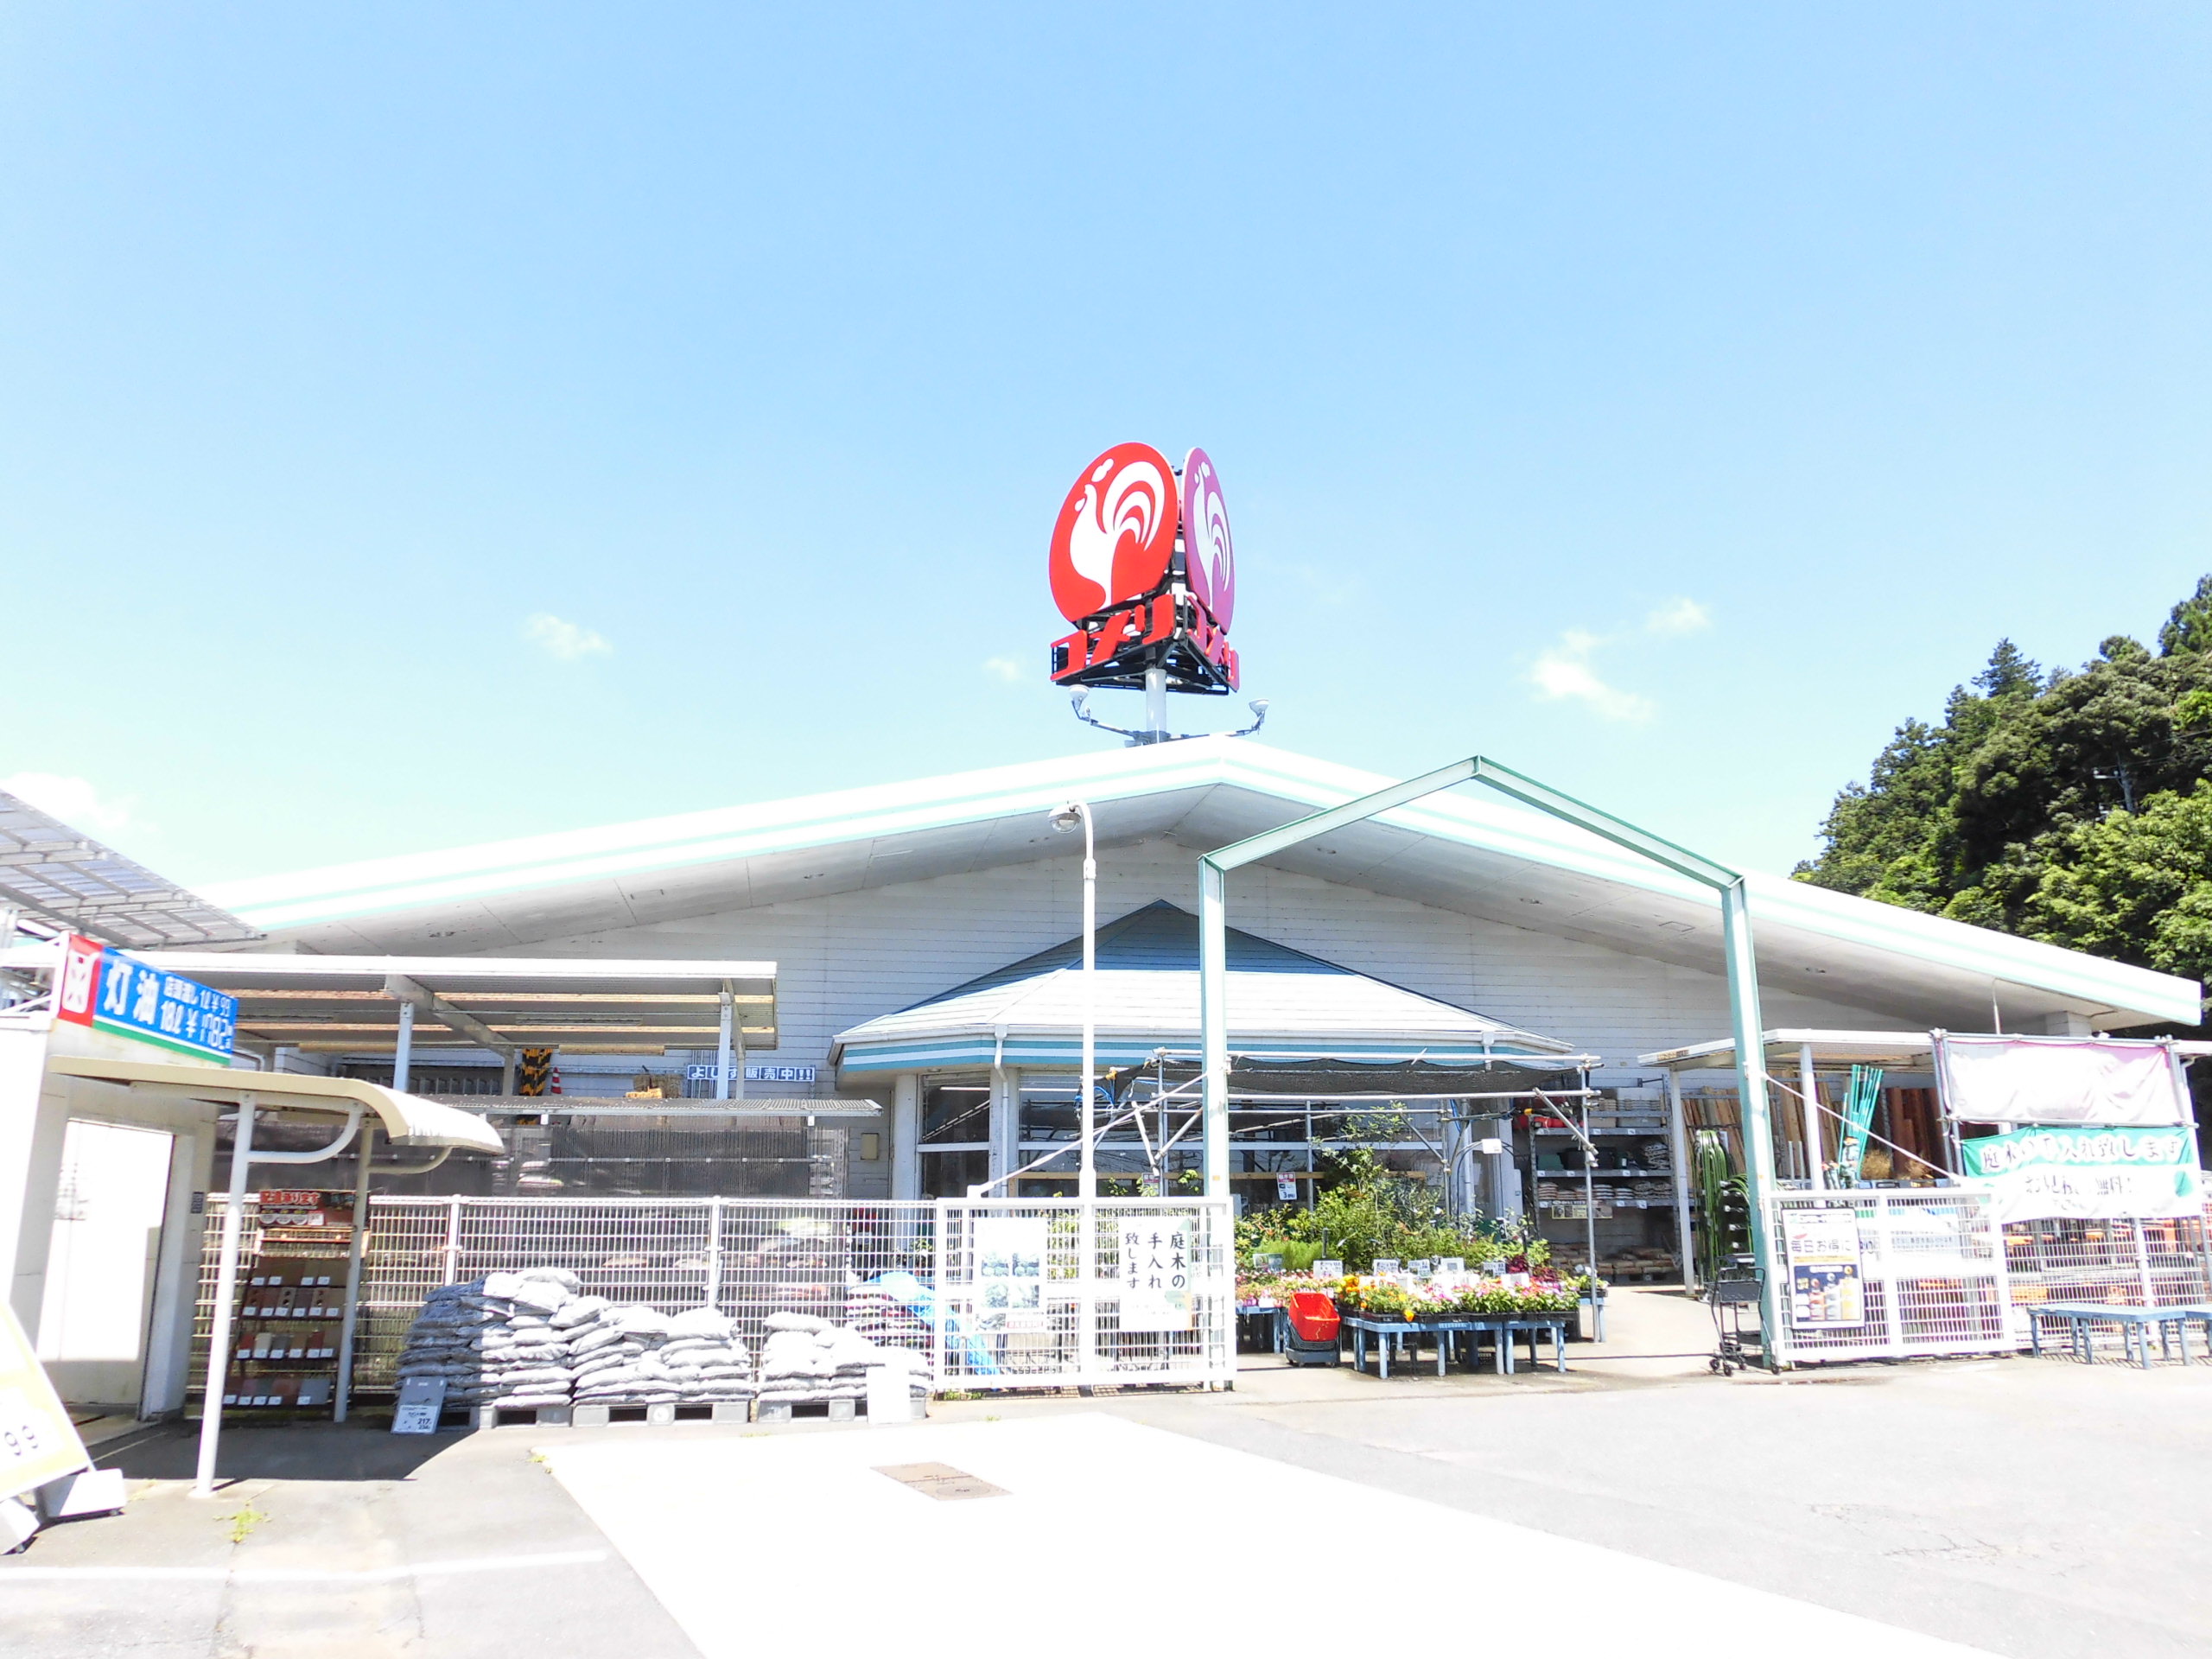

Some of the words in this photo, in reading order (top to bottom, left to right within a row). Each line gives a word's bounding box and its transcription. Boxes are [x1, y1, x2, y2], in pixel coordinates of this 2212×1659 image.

[1050, 593, 1176, 682] コメリ
[103, 958, 160, 1026] 灯油
[1124, 1231, 1141, 1289] 致します
[1147, 1231, 1164, 1289] 手入れ
[1169, 1230, 1187, 1289] 庭木の
